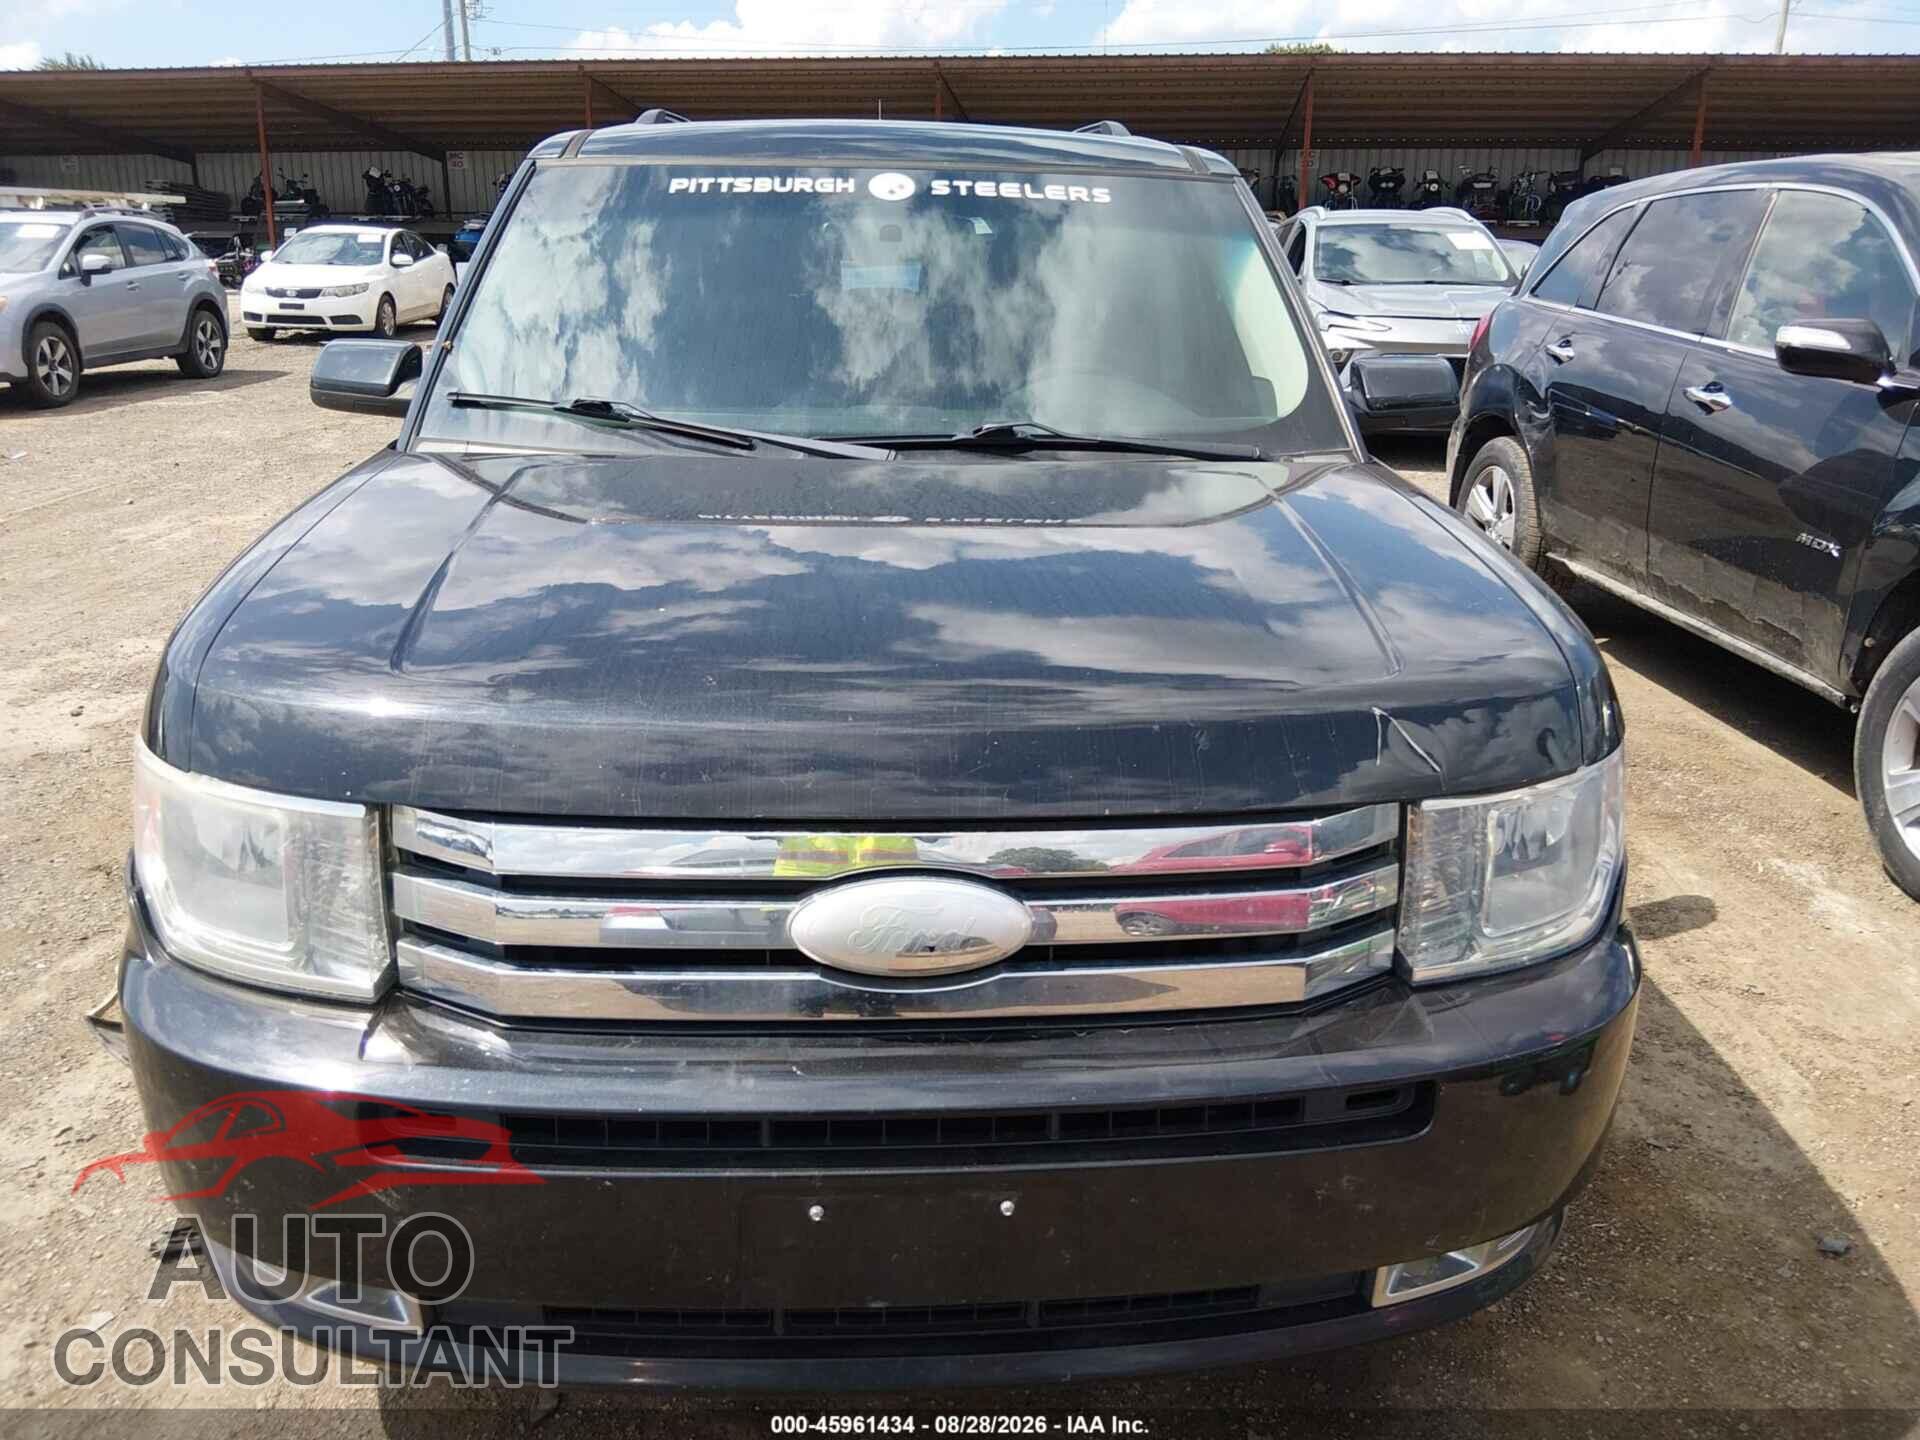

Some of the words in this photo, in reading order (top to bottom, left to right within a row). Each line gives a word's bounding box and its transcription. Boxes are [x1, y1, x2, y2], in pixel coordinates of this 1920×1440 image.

[668, 176, 856, 194] PITTSBURGH
[930, 179, 1113, 203] STEELERS
[1795, 532, 1841, 558] MDX
